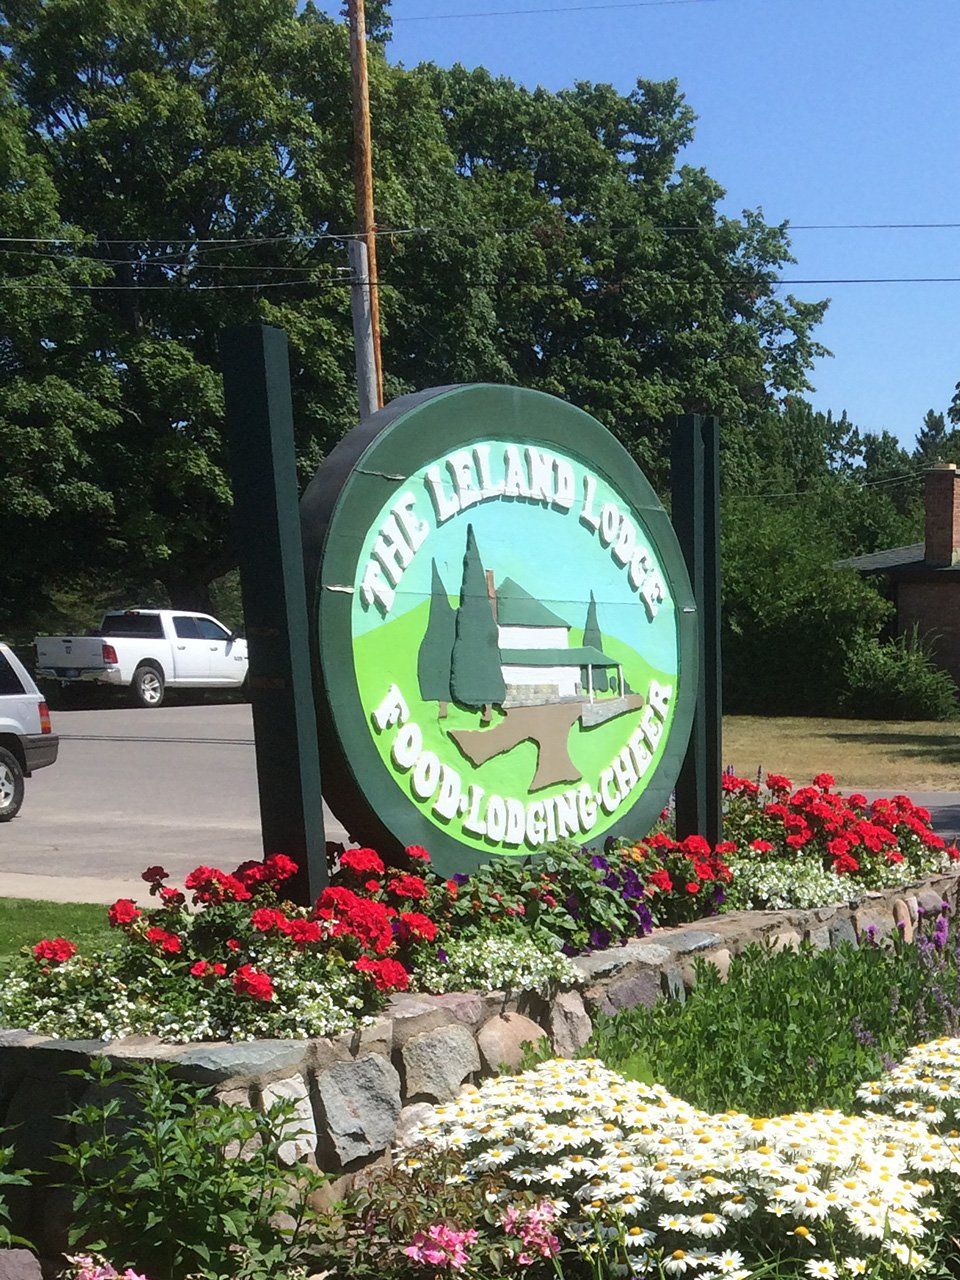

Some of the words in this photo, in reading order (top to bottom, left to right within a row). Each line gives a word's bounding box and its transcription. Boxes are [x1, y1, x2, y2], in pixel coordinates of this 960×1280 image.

[361, 492, 429, 616] THE
[424, 445, 575, 524] LELAND
[580, 475, 666, 621] LODGE
[371, 683, 460, 820] FOOD
[464, 783, 598, 846] LODGING
[598, 680, 673, 812] CHEER
